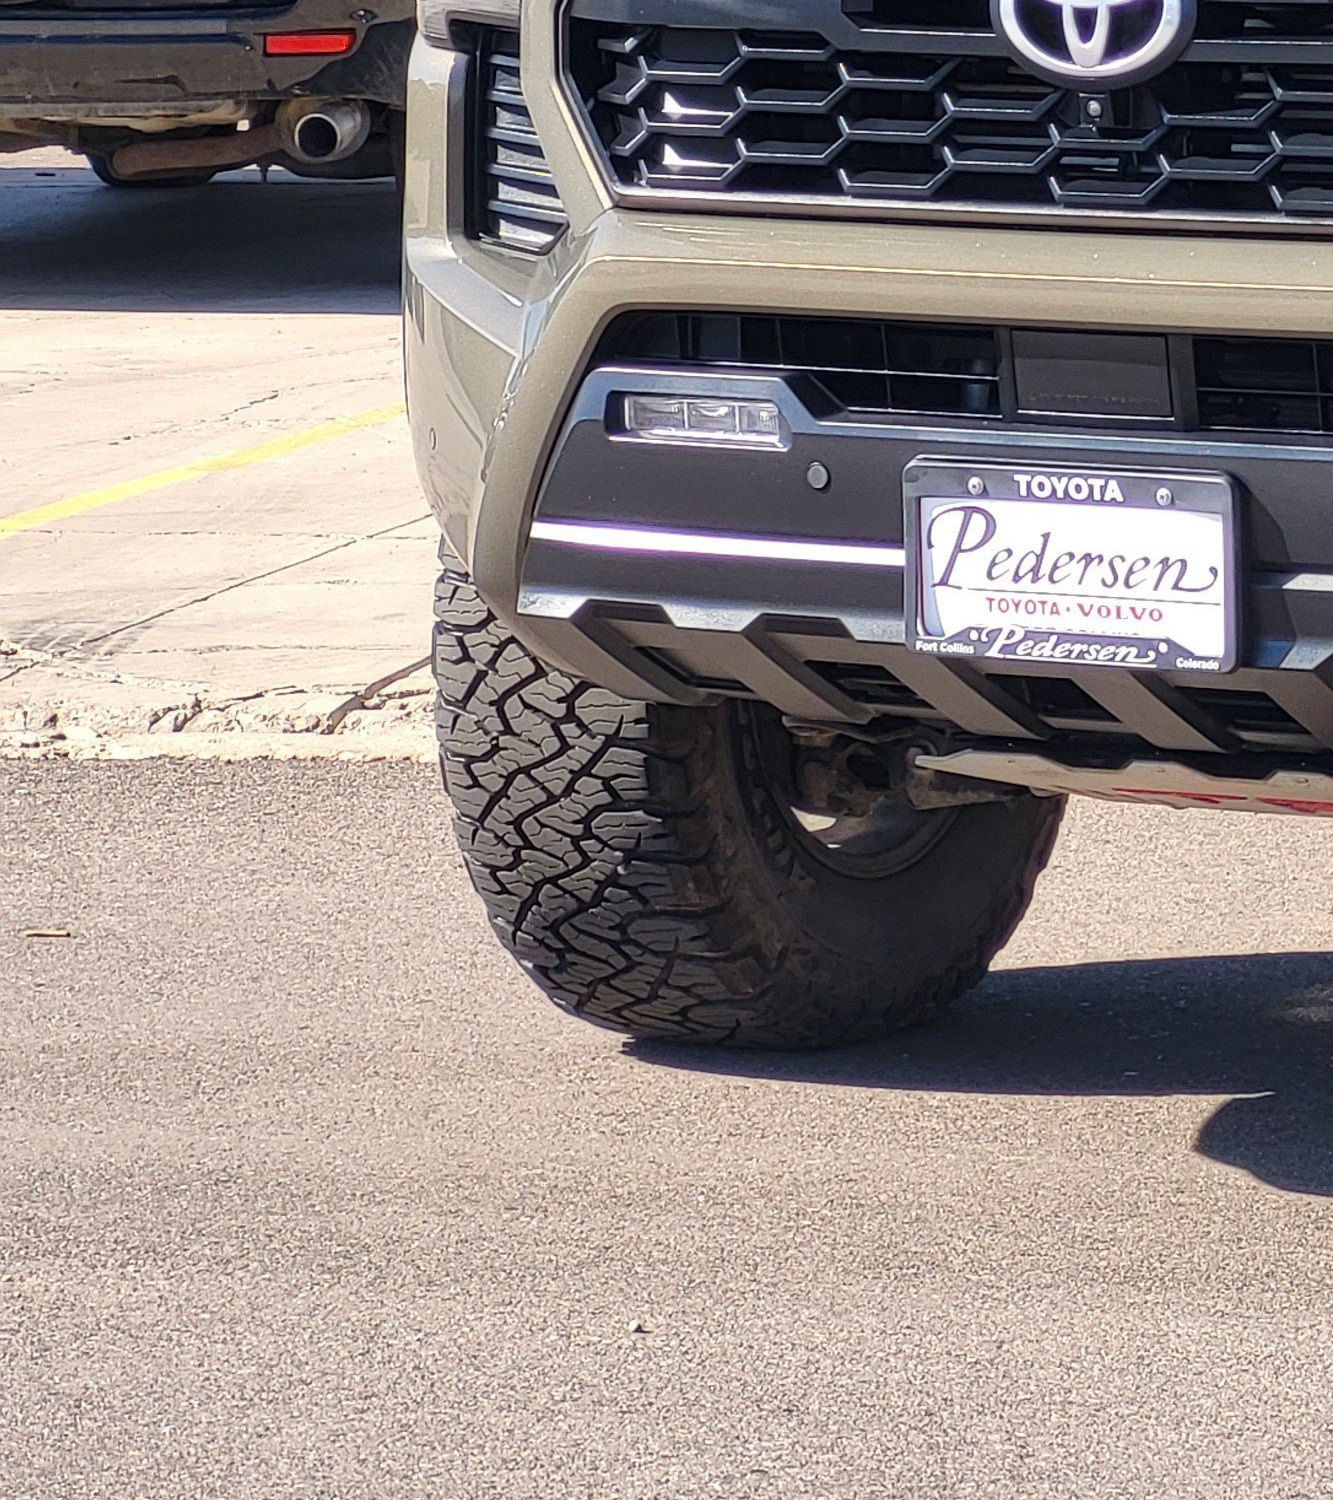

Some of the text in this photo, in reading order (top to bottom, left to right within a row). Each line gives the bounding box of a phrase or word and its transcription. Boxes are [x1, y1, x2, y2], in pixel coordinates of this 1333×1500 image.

[1013, 474, 1124, 502] TOYOTA
[927, 506, 1219, 592] Pedersen
[915, 640, 938, 652] Fort
[1176, 657, 1220, 671] Colorado
